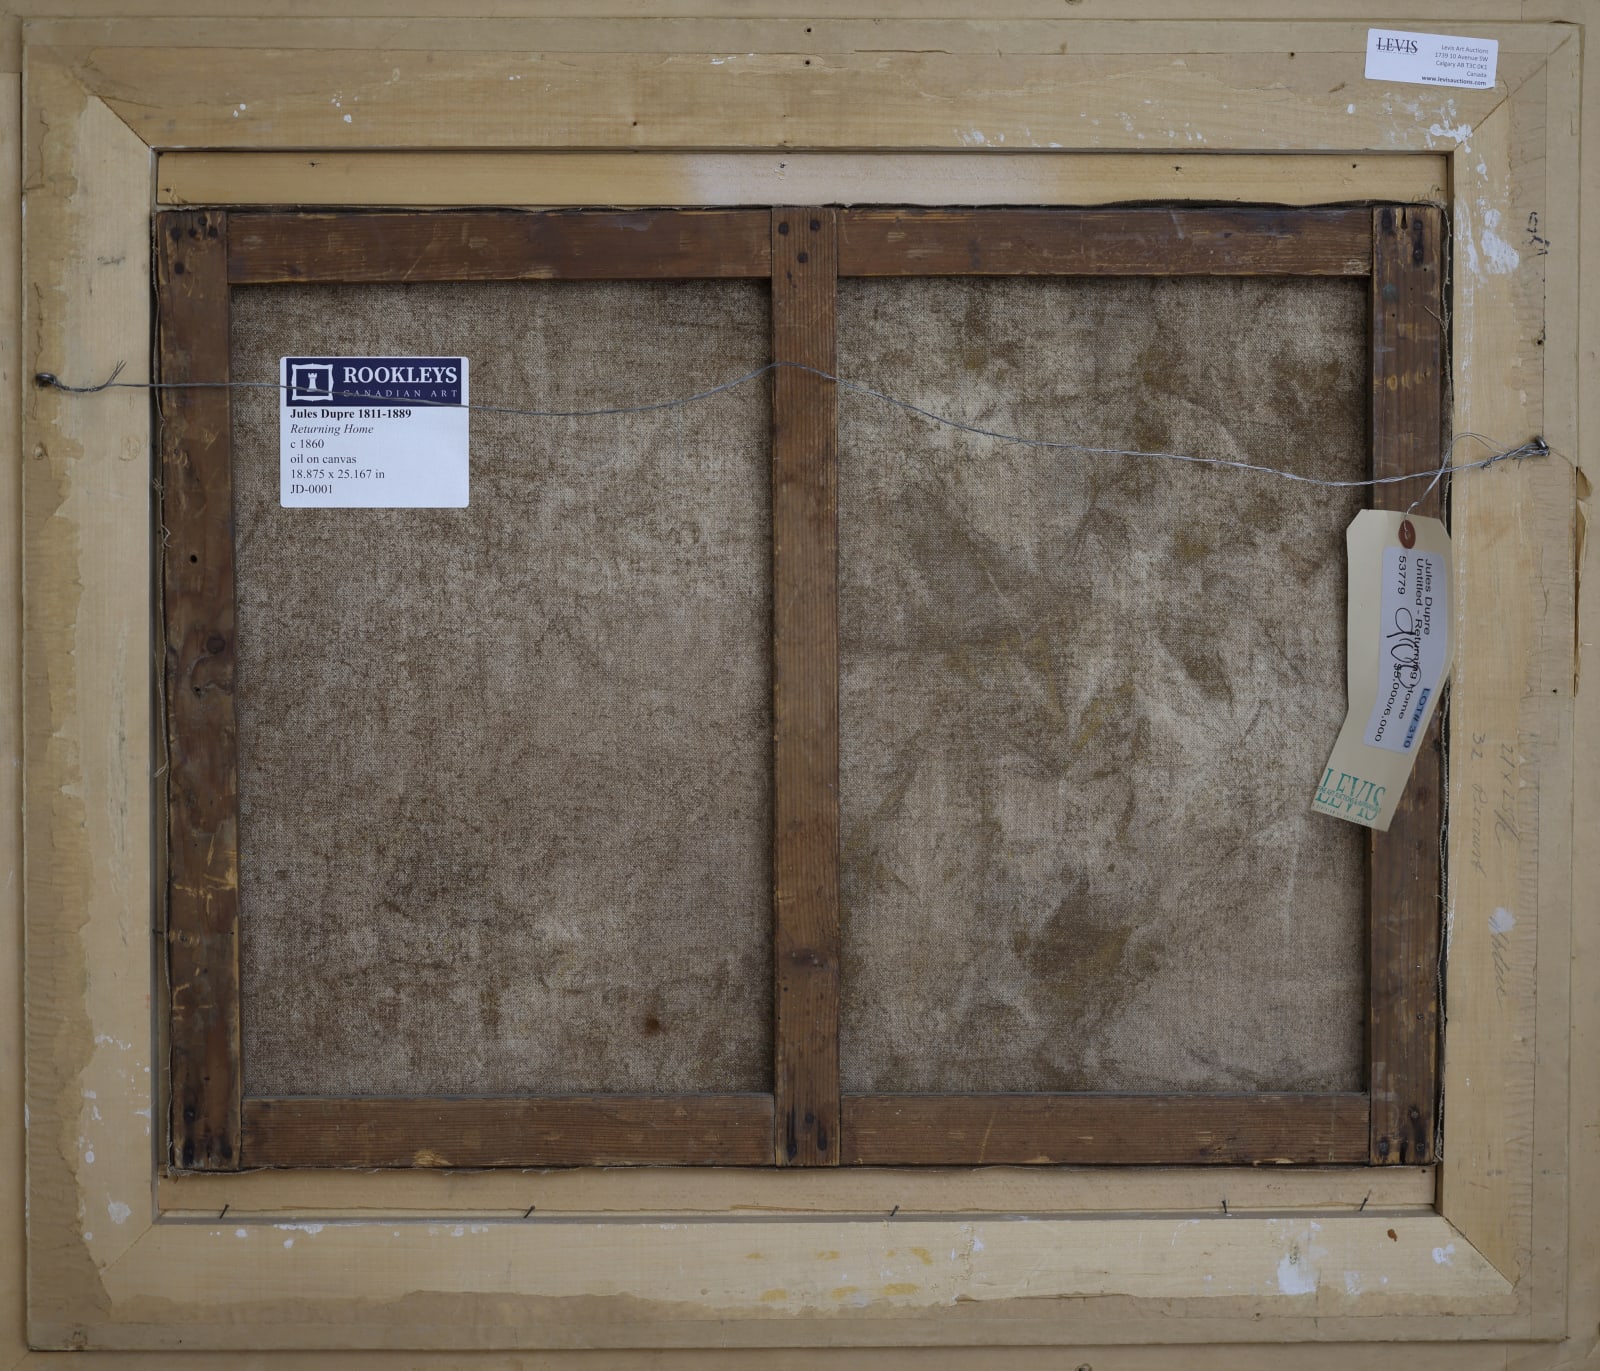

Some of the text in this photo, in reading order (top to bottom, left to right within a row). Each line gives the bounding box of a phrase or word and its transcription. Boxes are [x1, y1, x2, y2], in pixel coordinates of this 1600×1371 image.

[1378, 37, 1418, 54] LEVIS
[1466, 46, 1488, 54] Auctions
[1421, 75, 1486, 86] www.levisauctions.com
[343, 366, 458, 384] ROOKLEYS
[343, 390, 421, 398] CANADIAN
[290, 409, 412, 421] Jules Dupre 1811-1889
[290, 424, 374, 436] Returning Home
[290, 439, 325, 449] c 1860
[290, 454, 357, 464] oil on canvas
[291, 469, 385, 479] 18.875 x 25.167 in
[290, 484, 333, 494] JD-0001
[1398, 556, 1406, 594] 53779
[1416, 559, 1424, 606] Untitled
[1423, 597, 1432, 635] Dupre
[1410, 619, 1422, 679] Returning
[1399, 684, 1416, 719] Home
[1403, 688, 1431, 748] LOT# 310
[1315, 768, 1386, 821] LEVIS
